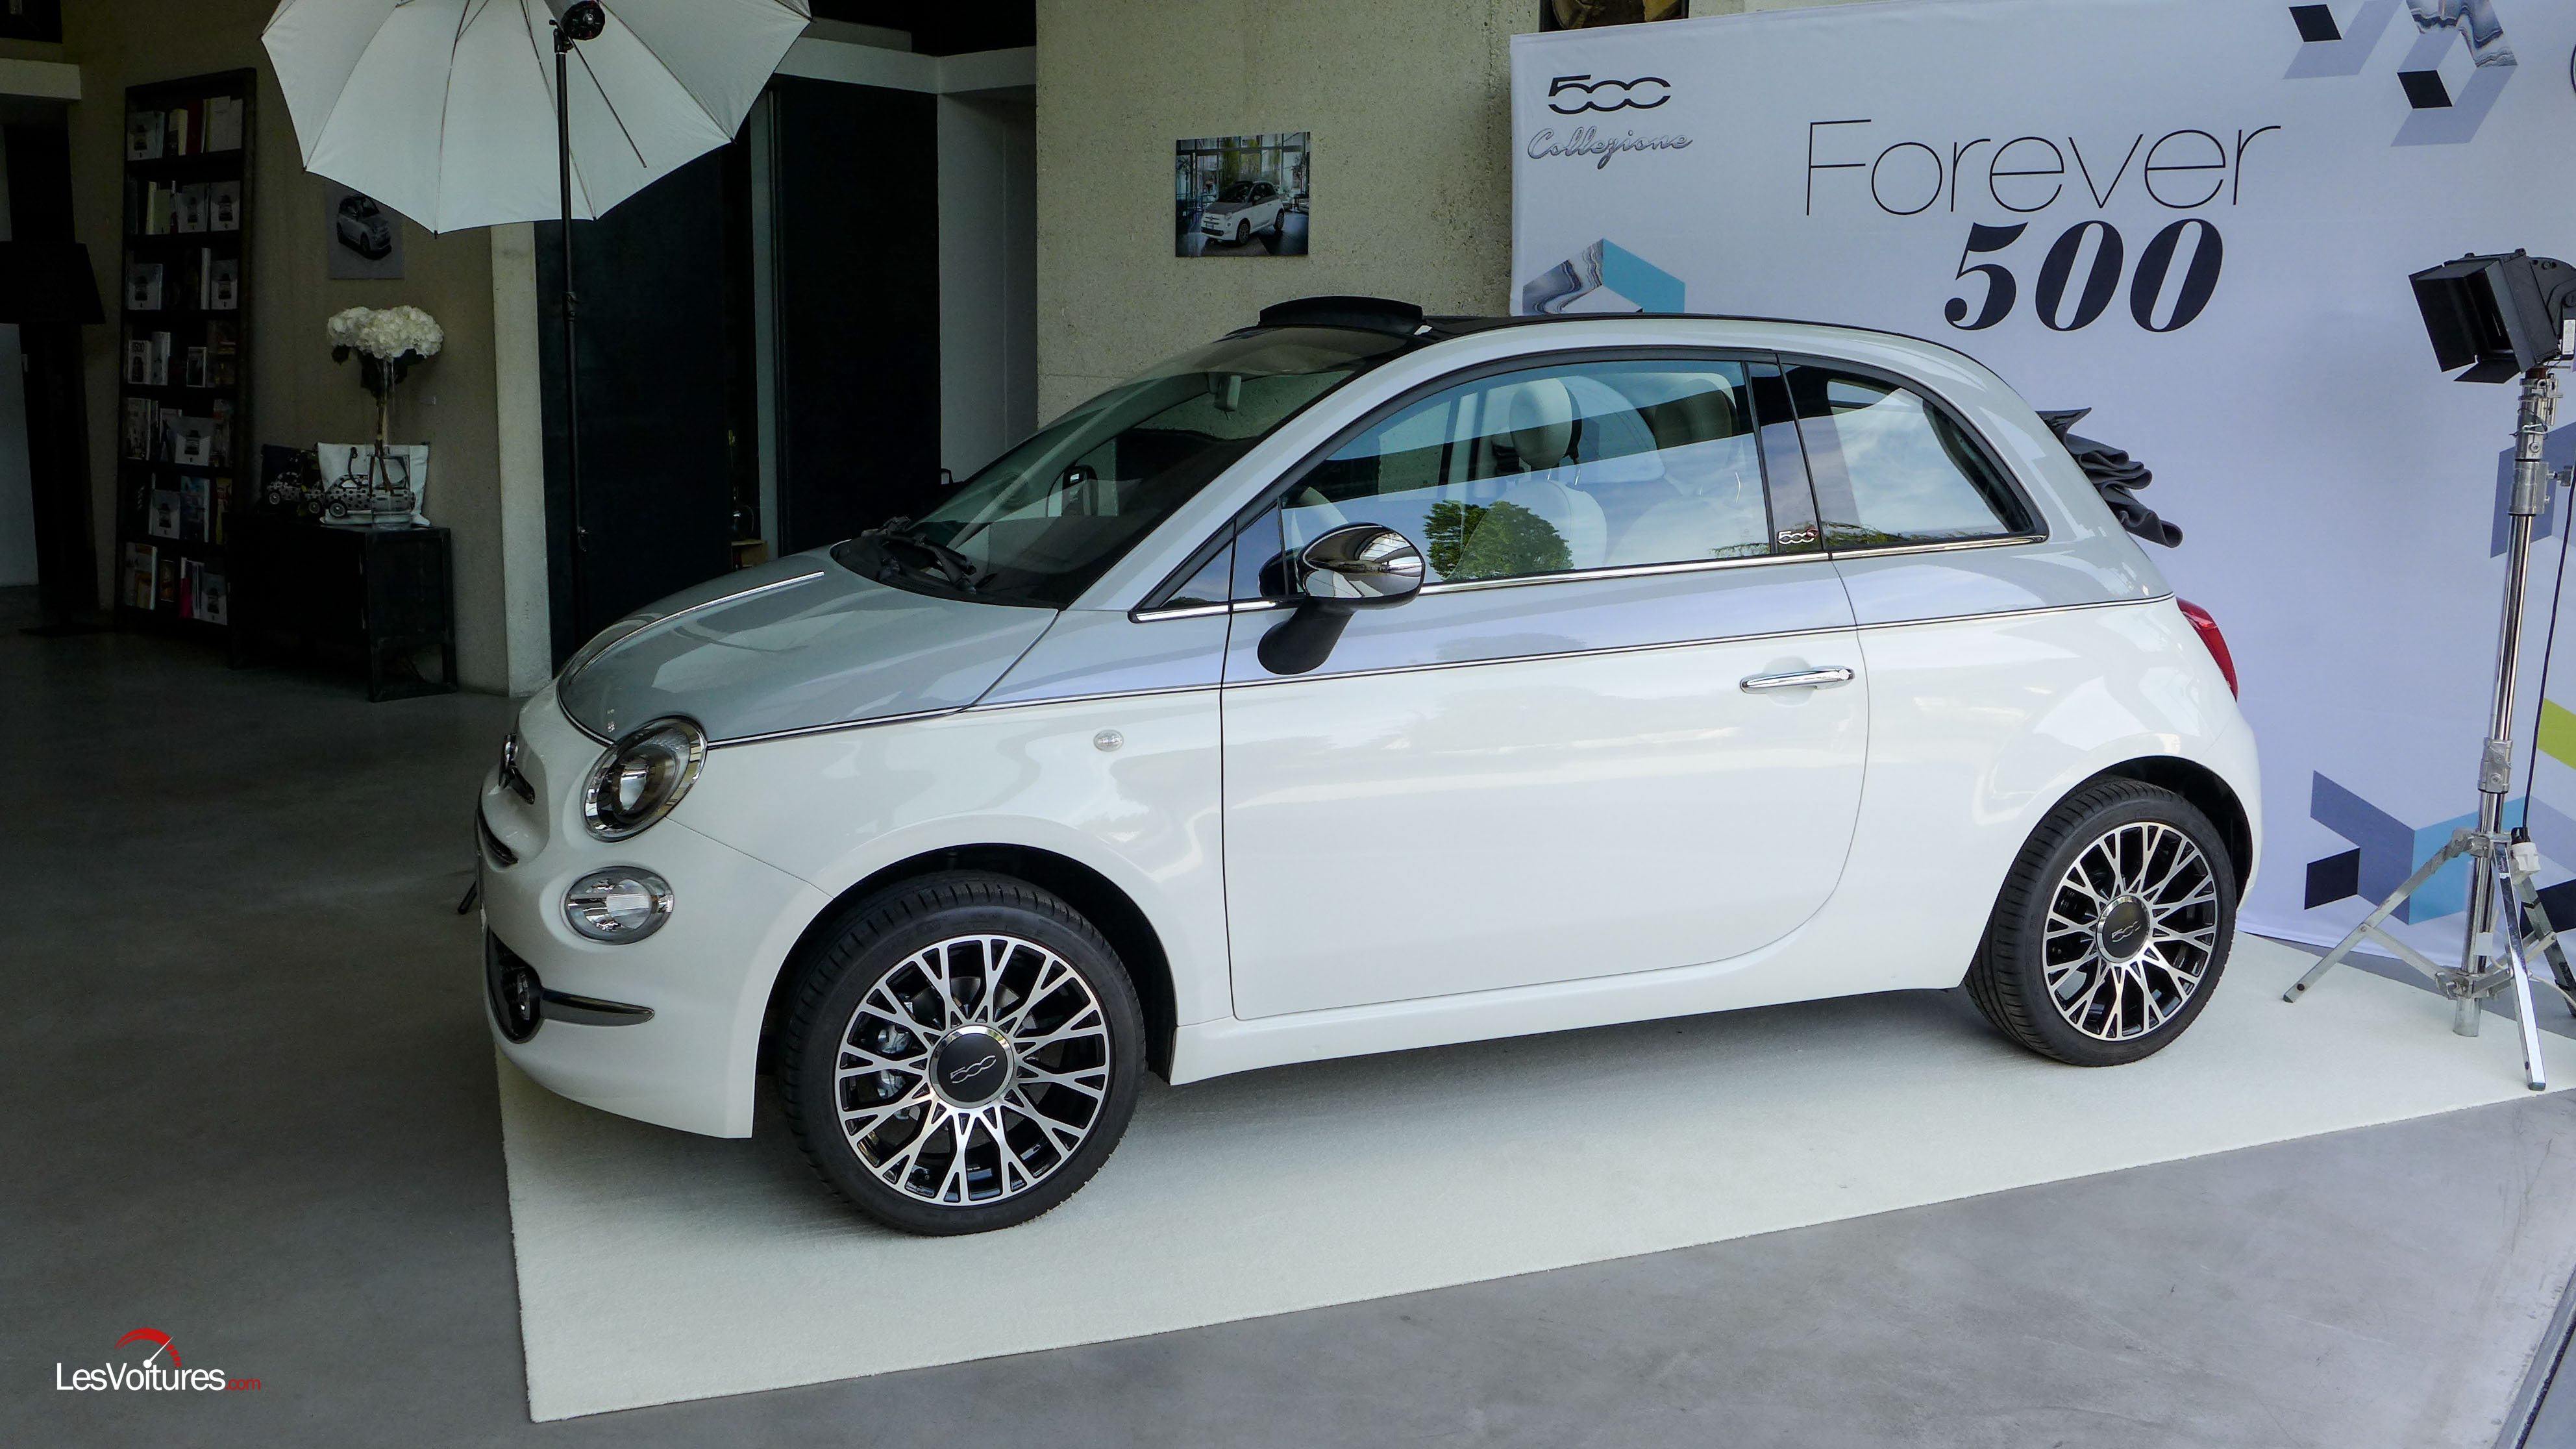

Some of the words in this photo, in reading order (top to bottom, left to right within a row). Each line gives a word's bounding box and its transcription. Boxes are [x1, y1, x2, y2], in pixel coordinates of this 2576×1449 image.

[1548, 74, 1671, 115] 500
[1527, 125, 1693, 170] Collezione
[1806, 119, 2281, 216] Forever
[1944, 218, 2223, 332] 500
[950, 1055, 997, 1084] 500
